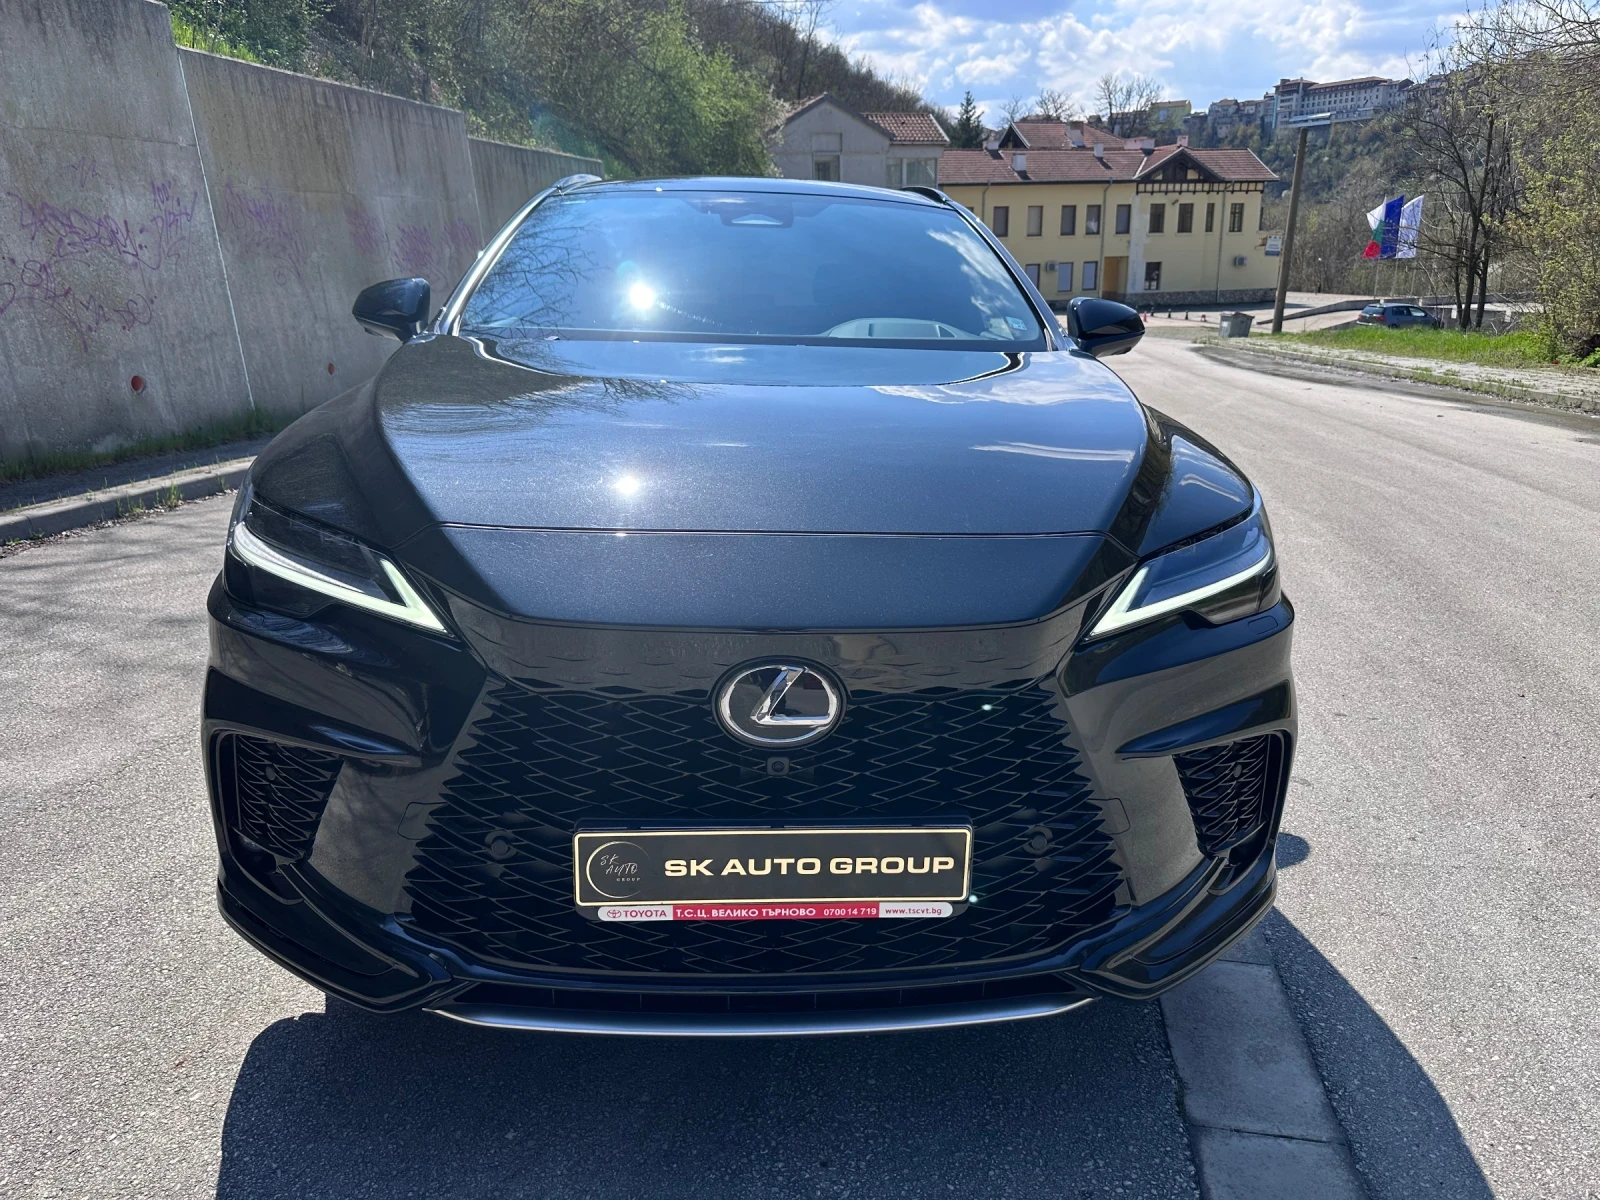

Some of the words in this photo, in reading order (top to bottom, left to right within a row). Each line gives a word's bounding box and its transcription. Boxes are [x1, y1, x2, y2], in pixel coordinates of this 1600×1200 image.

[600, 853, 620, 866] SK
[664, 859, 714, 876] SK
[720, 858, 821, 876] AUTO
[829, 856, 955, 874] GROUP
[623, 909, 667, 918] TOYOTA
[712, 908, 759, 917] ВЕЛИКО
[762, 908, 816, 917] ТЪРНОВО
[860, 907, 877, 915] 719
[885, 907, 942, 916] www.tscvt.bg
